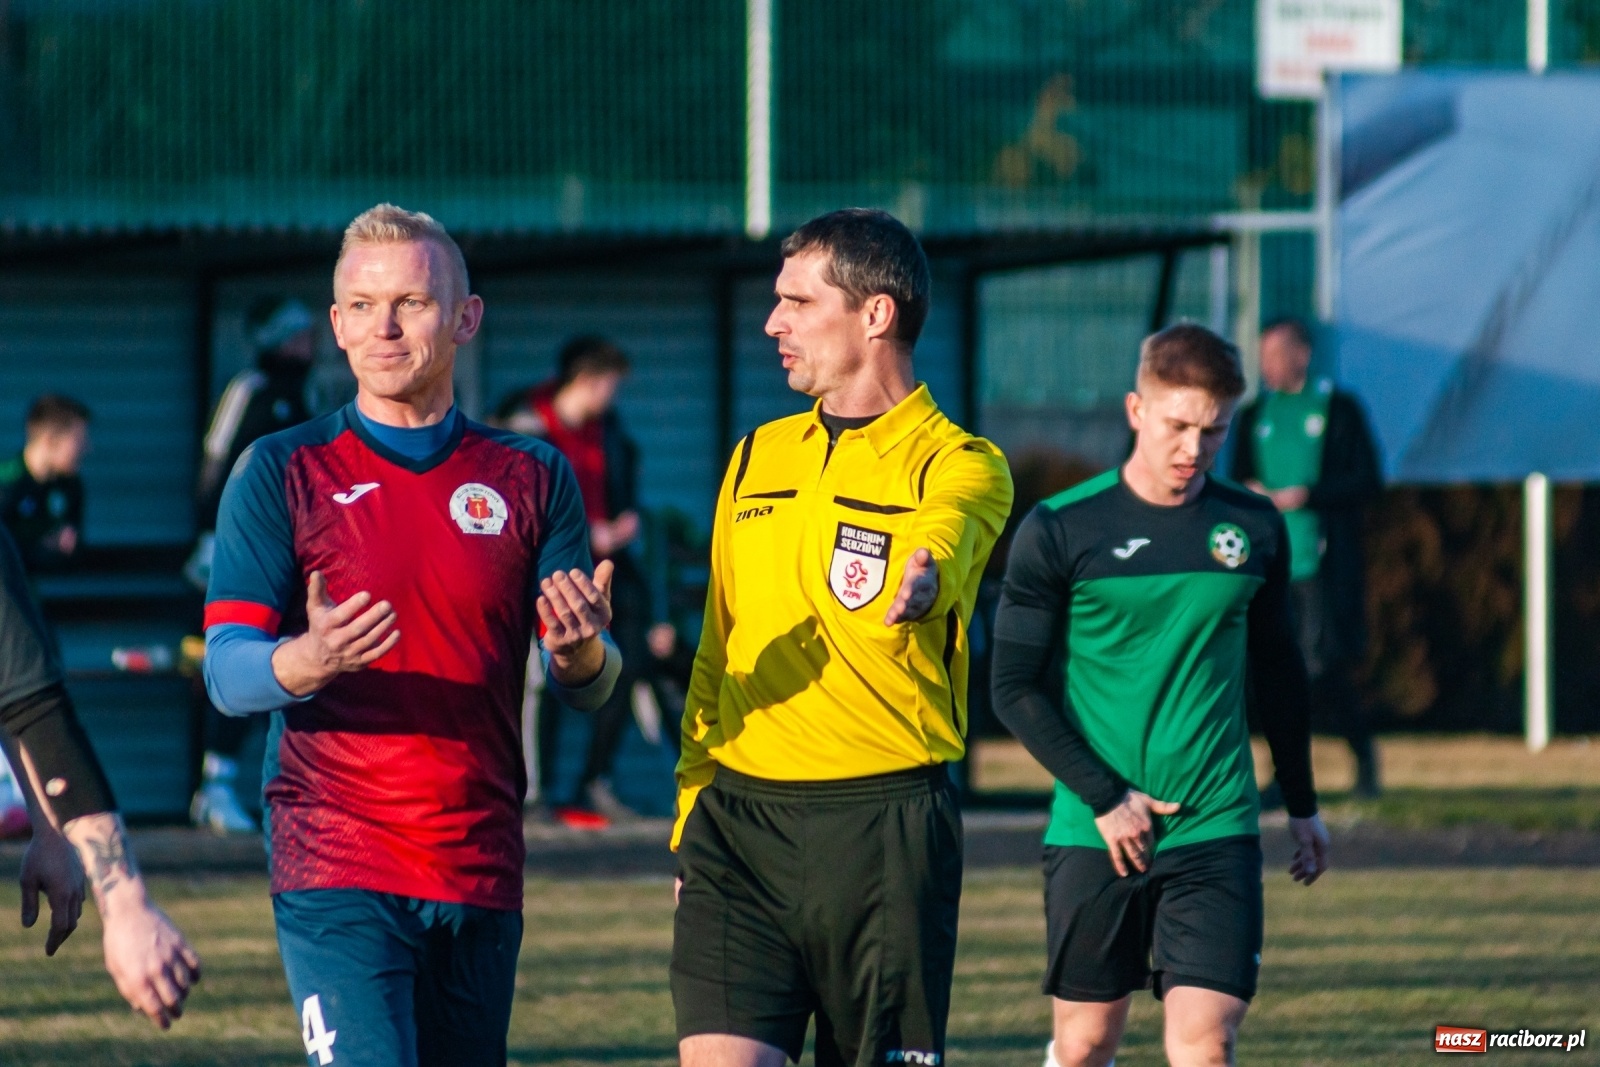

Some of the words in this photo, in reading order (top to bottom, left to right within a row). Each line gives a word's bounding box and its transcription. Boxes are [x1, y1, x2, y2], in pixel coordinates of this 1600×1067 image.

[841, 526, 886, 546] KOLEGIUM
[840, 537, 882, 556] SĘDZIÓW
[842, 589, 861, 600] PZPN
[302, 994, 337, 1066] 4
